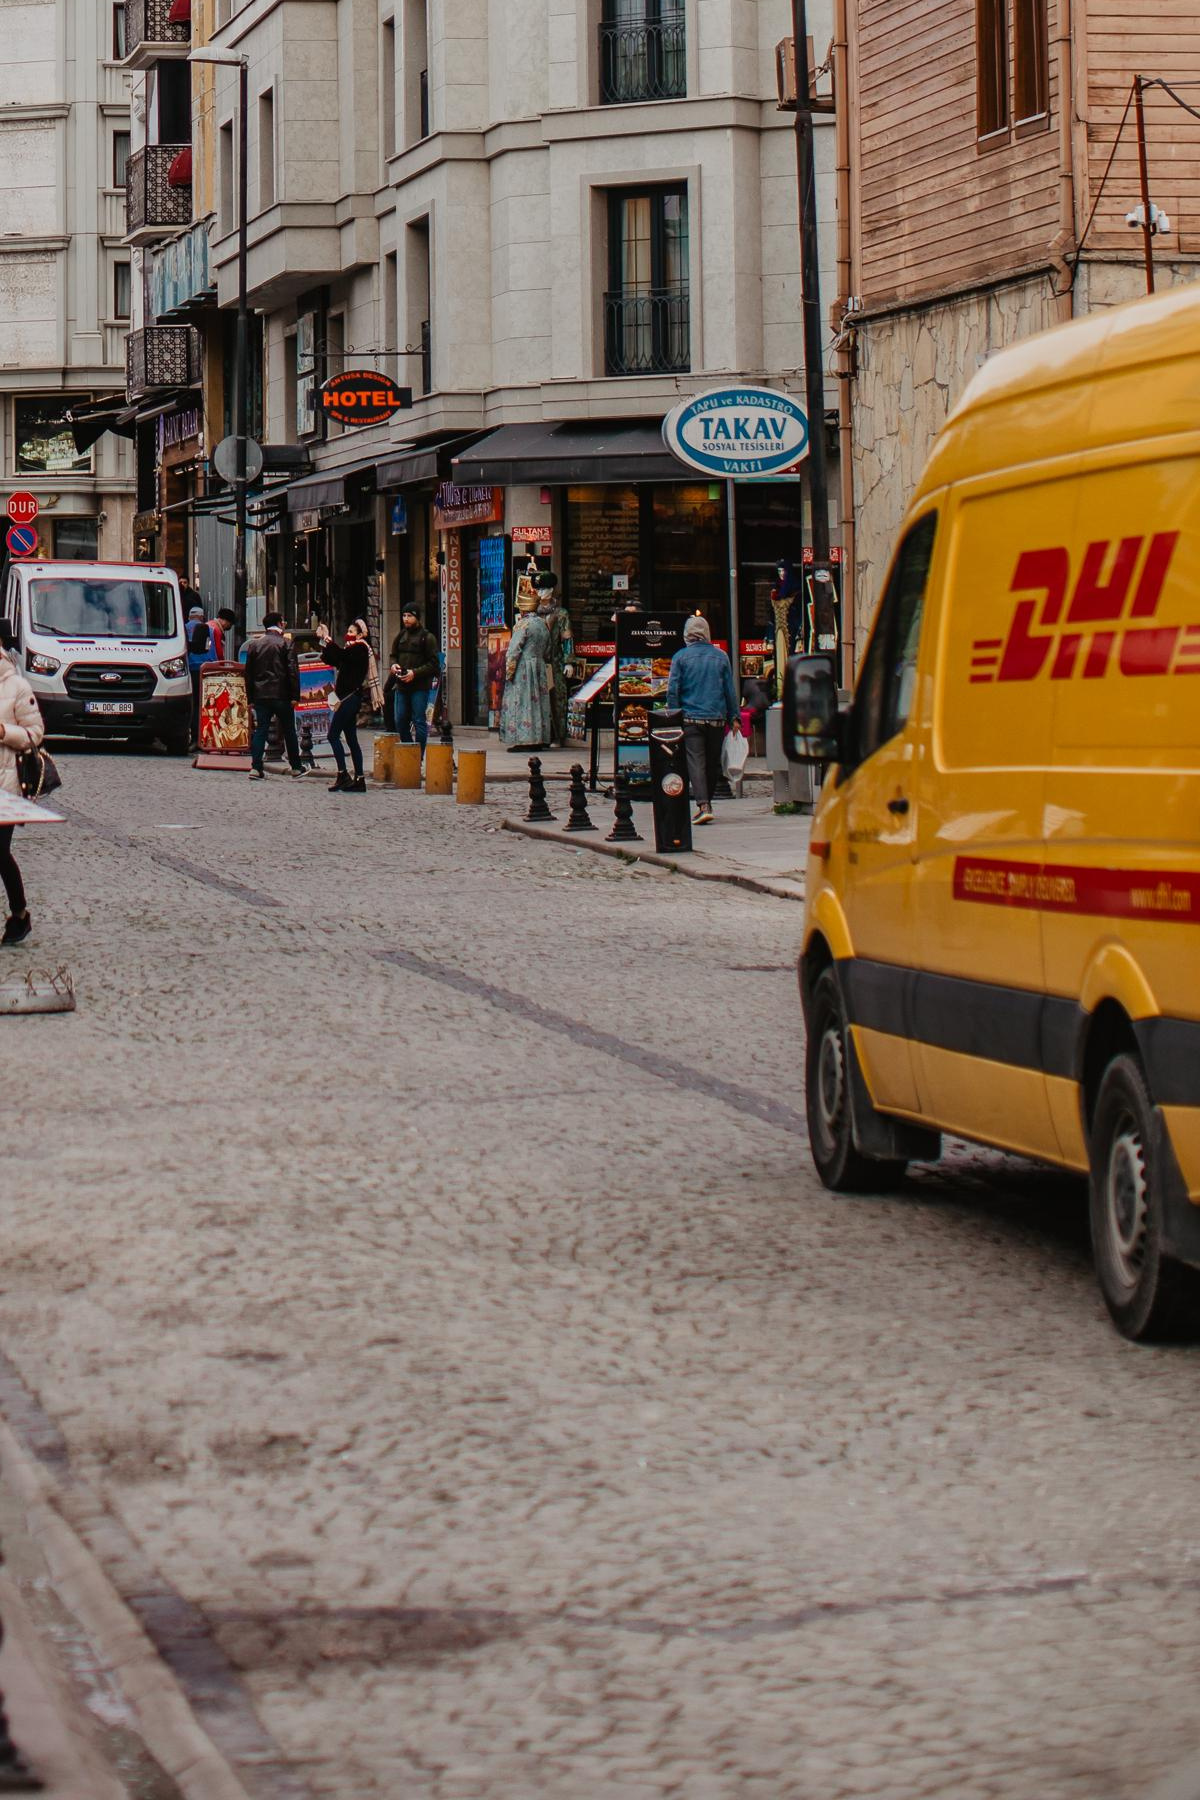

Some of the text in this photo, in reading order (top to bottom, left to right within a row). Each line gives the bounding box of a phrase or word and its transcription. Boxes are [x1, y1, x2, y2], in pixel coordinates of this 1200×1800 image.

[323, 391, 400, 406] HOTEL
[690, 398, 718, 415] TAPU
[736, 395, 794, 414] KADASTRO
[700, 417, 787, 440] TAKAV
[702, 442, 736, 451] SOSYAL
[723, 460, 763, 472] VAKFI
[9, 501, 36, 514] DUR
[997, 530, 1181, 682] DHL
[90, 703, 99, 712] 34
[119, 703, 132, 712] 889
[1131, 882, 1191, 911] www.dhl.com
